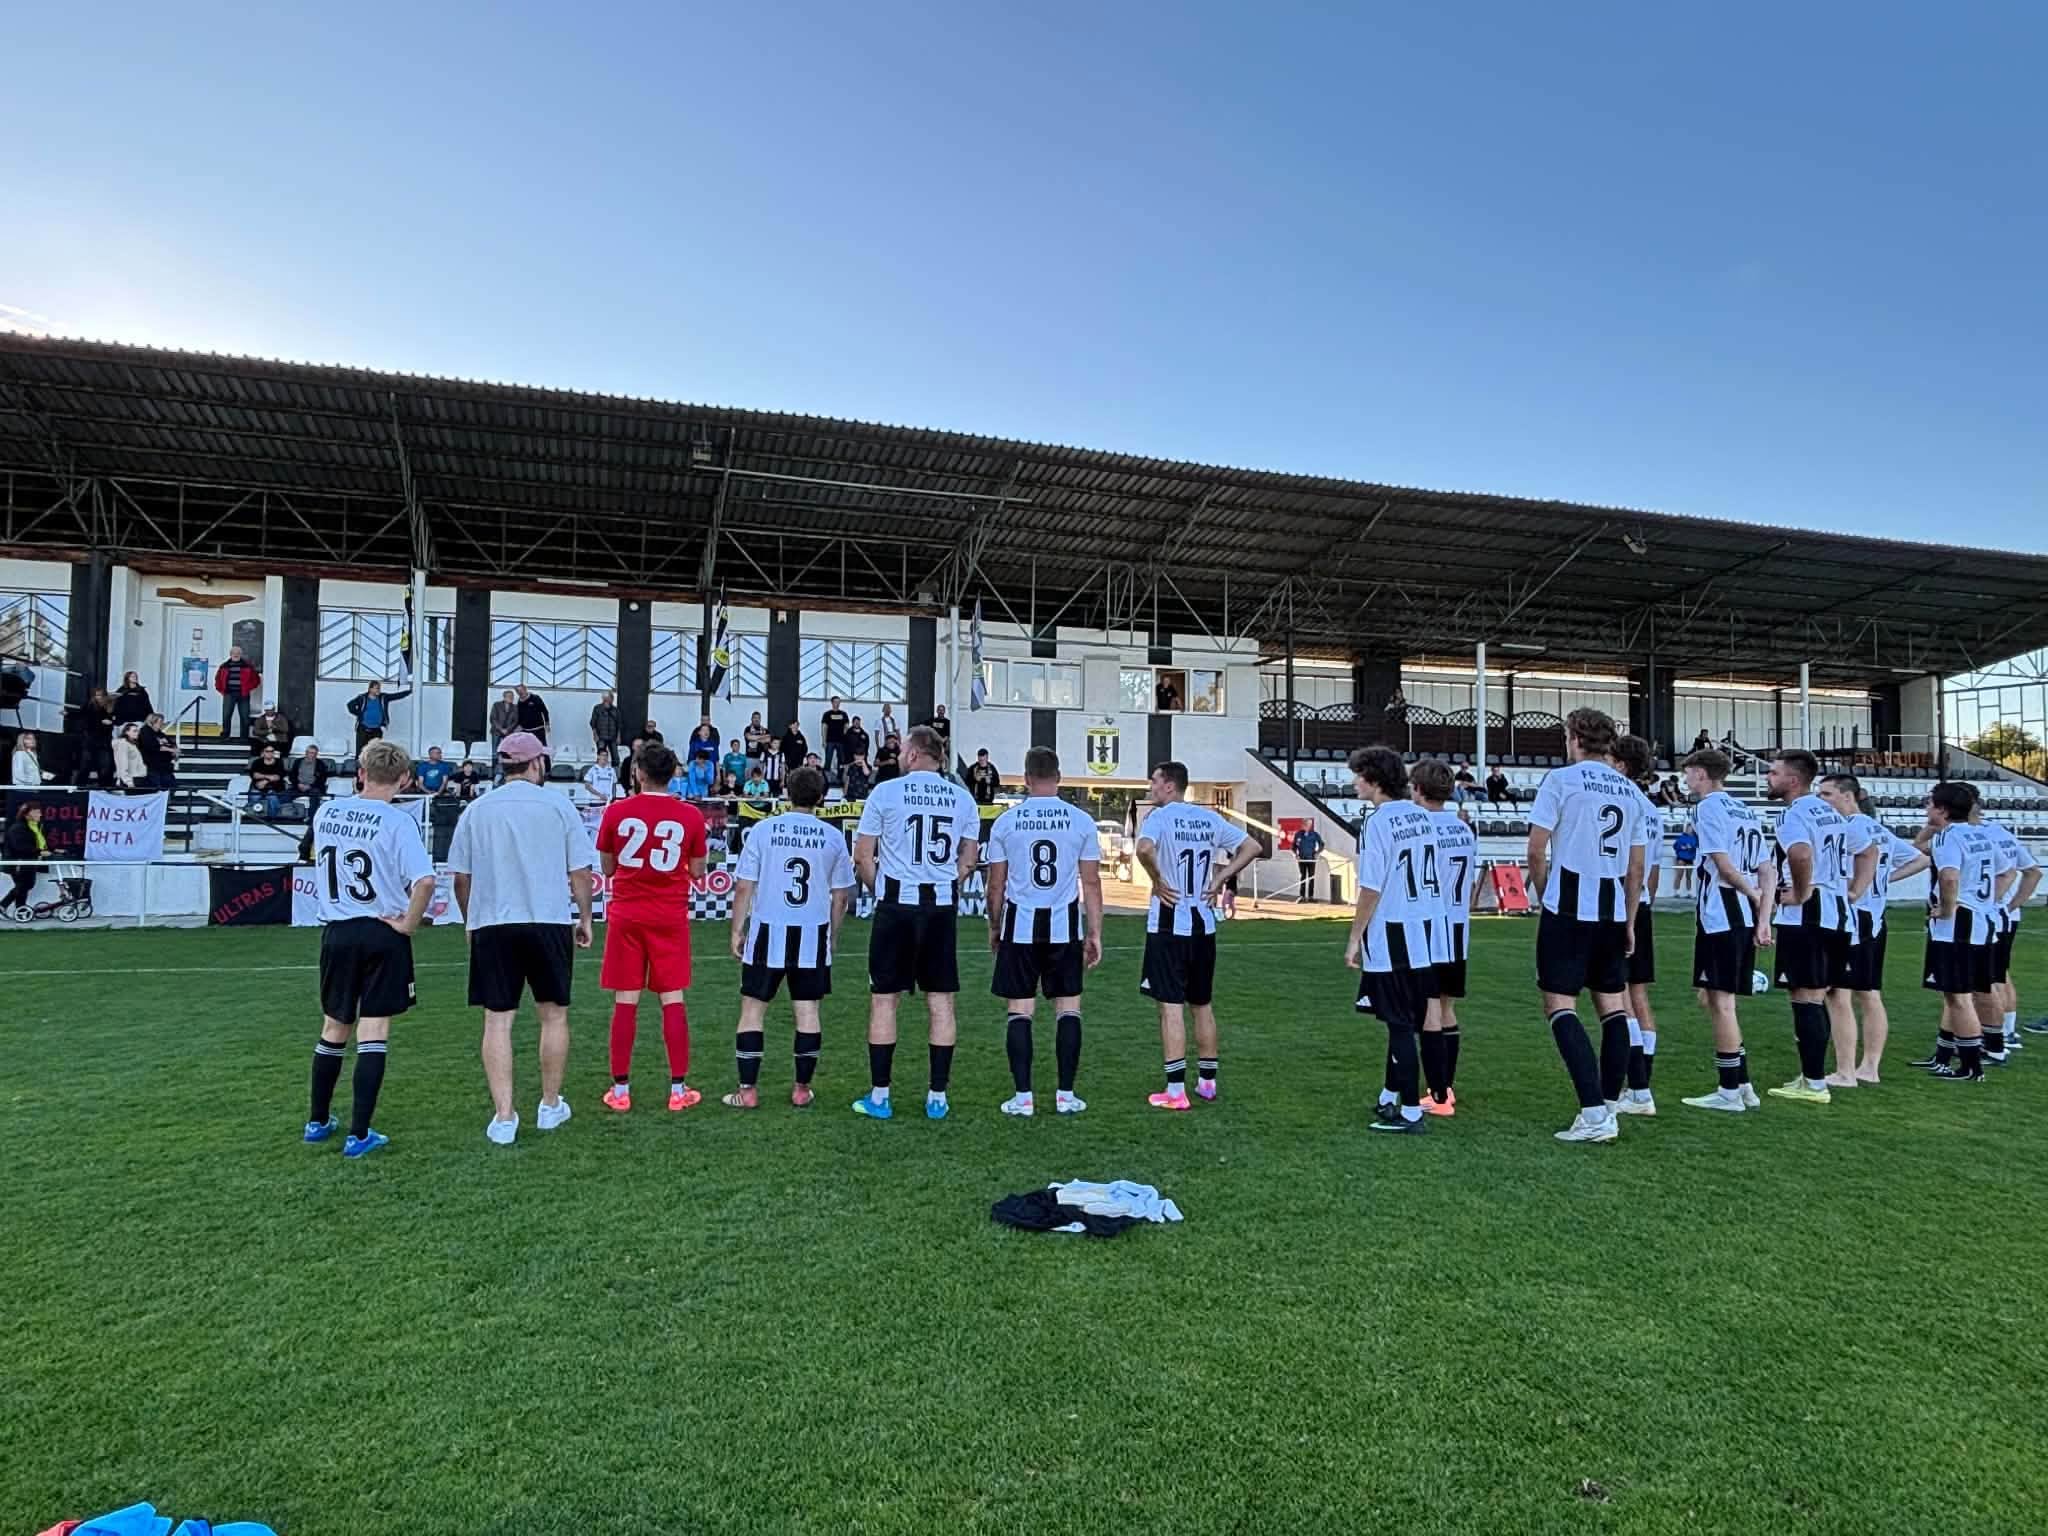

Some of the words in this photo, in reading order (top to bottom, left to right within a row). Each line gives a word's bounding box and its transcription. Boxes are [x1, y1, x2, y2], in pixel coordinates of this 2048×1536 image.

[904, 783, 918, 793] FC
[924, 784, 954, 796] SIGMA
[1581, 770, 1596, 779] FC
[325, 807, 338, 819] FC
[346, 810, 383, 827] SIGMA
[904, 795, 957, 809] HODOLANY
[1017, 809, 1030, 819] FC
[1037, 808, 1069, 818] SIGMA
[1389, 817, 1402, 829] FC
[319, 822, 380, 841] HODOLANY
[617, 817, 685, 872] 23
[771, 836, 827, 849] HODOLANY
[773, 824, 786, 833] FC
[793, 825, 825, 837] SIGMA
[904, 813, 955, 867] 15
[1015, 820, 1071, 831] HODOLANY
[1174, 818, 1185, 829] FC
[1598, 804, 1624, 858] 2
[1029, 839, 1058, 890] 8
[1734, 826, 1762, 875] 10
[318, 844, 377, 905] 13
[784, 856, 811, 909] 3
[1177, 849, 1211, 898] 11
[1396, 844, 1440, 902] 14
[1449, 855, 1468, 906] 7
[1976, 859, 1992, 903] 5
[214, 882, 274, 924] ULTRAS
